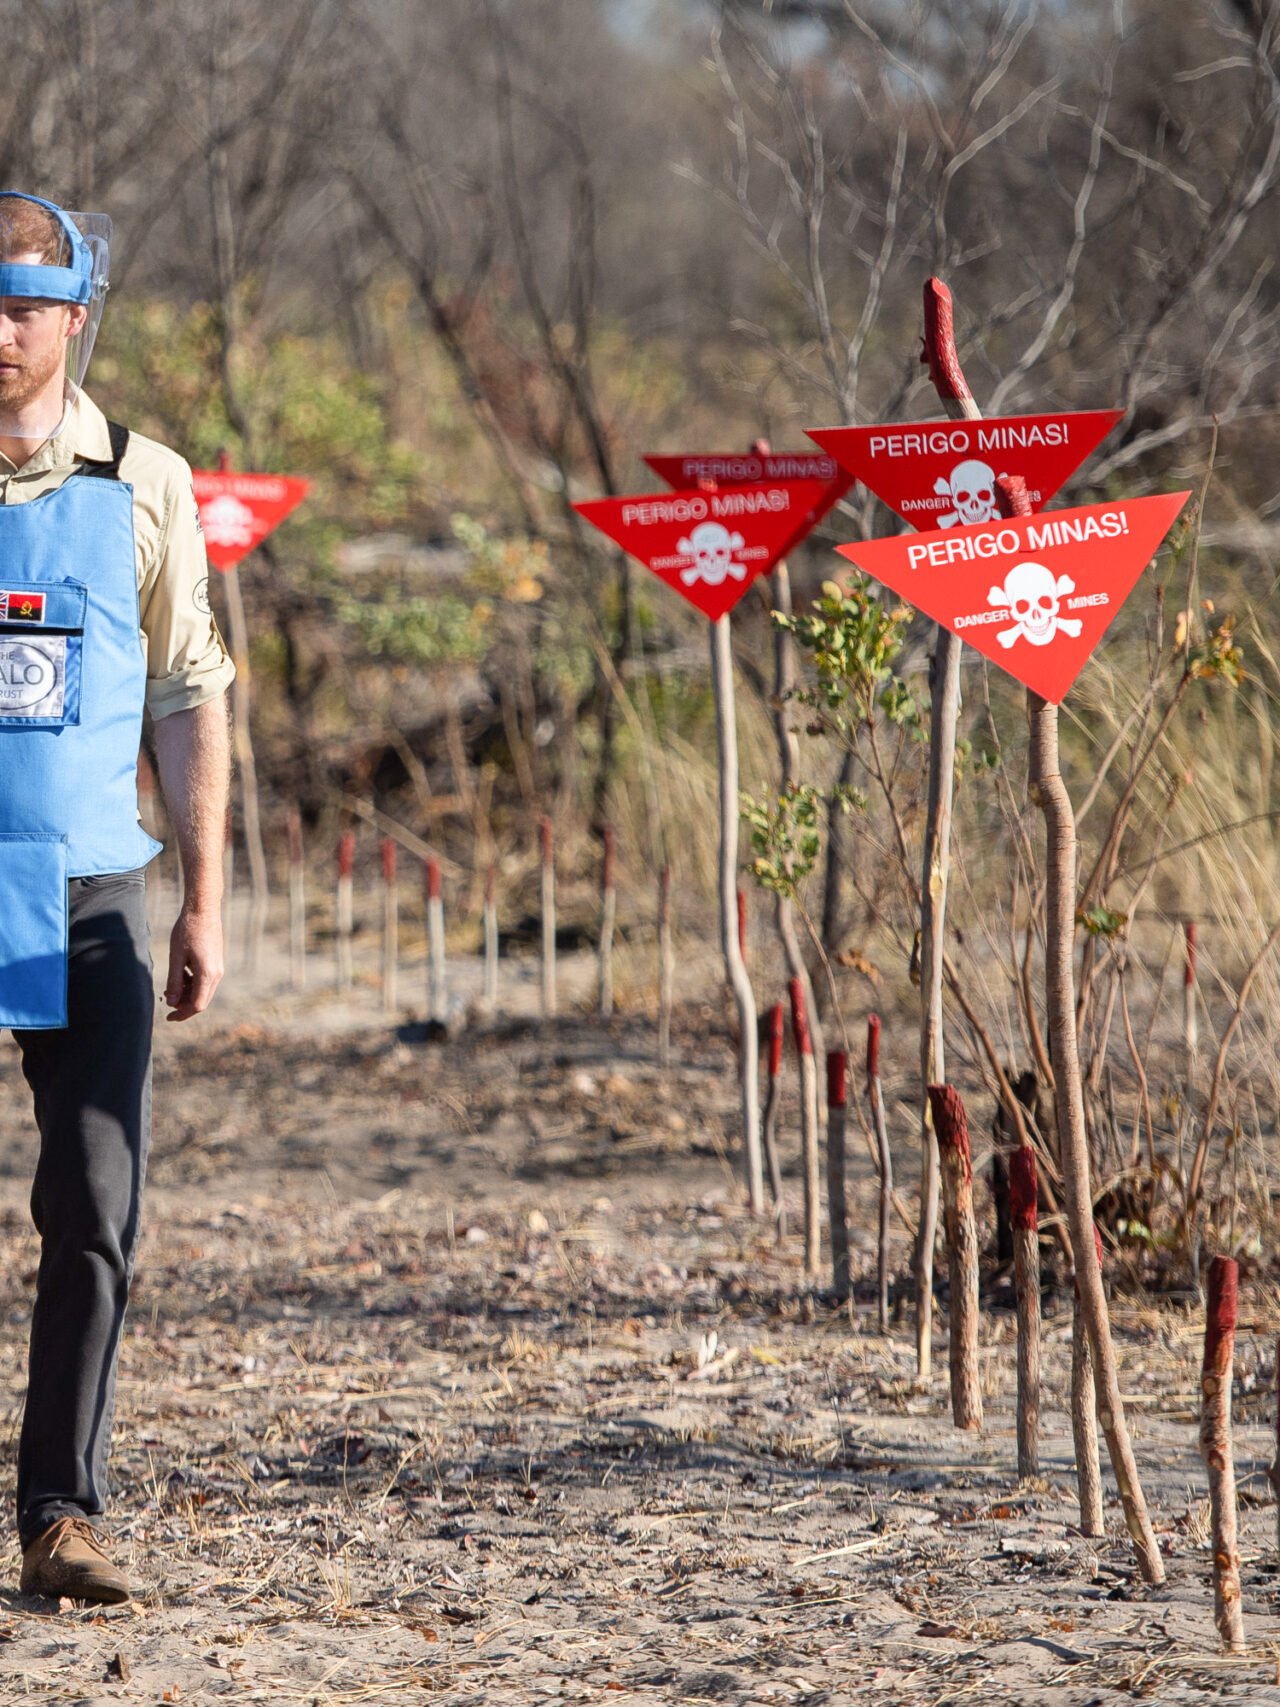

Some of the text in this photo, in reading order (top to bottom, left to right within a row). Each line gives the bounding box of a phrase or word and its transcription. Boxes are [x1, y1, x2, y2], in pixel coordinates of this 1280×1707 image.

[870, 423, 1069, 458] PERIGO MINAS!
[622, 496, 708, 527] PERIGO
[711, 488, 790, 518] MINAS!
[901, 497, 950, 512] DANGER
[907, 511, 1130, 570] PERIGO MINAS!
[953, 593, 1109, 629] DANGER MINES
